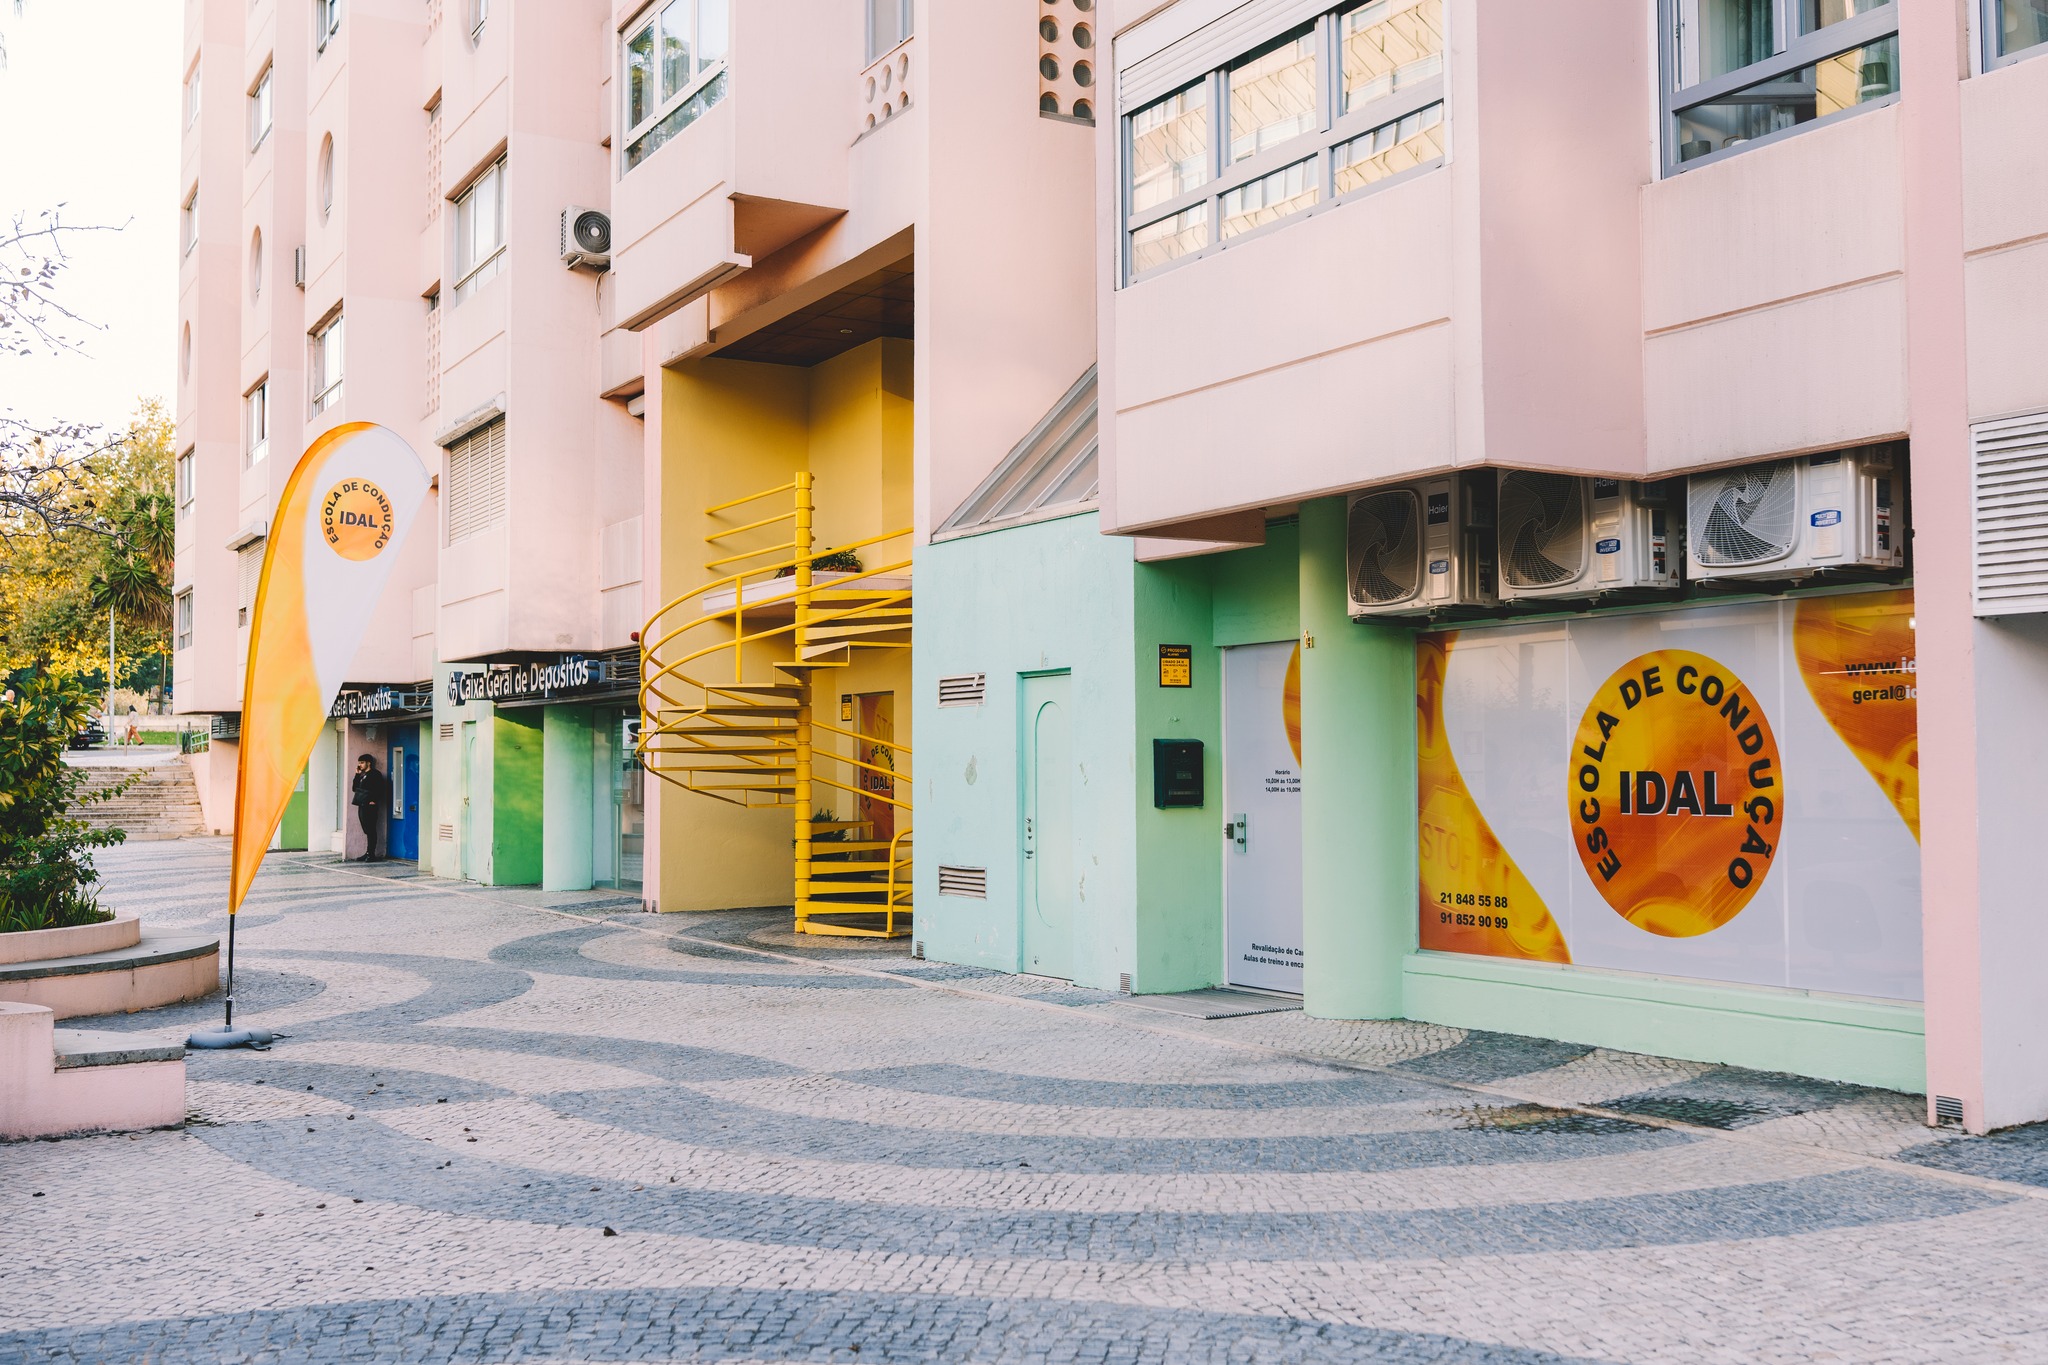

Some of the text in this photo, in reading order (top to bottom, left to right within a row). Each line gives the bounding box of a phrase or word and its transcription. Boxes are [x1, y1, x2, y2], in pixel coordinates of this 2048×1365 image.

[325, 482, 391, 549] ESCOLA DE CONDUÇÃO
[1428, 504, 1448, 514] Haier
[340, 511, 378, 528] IDAL
[460, 672, 485, 700] Caixa
[486, 667, 513, 698] Geral
[515, 664, 527, 693] de
[348, 694, 356, 715] de
[871, 745, 879, 758] DE
[871, 776, 890, 790] IDAL
[1579, 665, 1774, 889] ESCOLA DE CONDUÇÃO
[1619, 770, 1734, 817] IDAL
[1440, 892, 1508, 908] 21 848 55 88
[1440, 912, 1508, 929] 91 852 90 99
[1252, 943, 1285, 954] Revalidação
[1286, 947, 1293, 955] de
[1244, 954, 1258, 962] Aulas
[1268, 957, 1284, 966] treino
